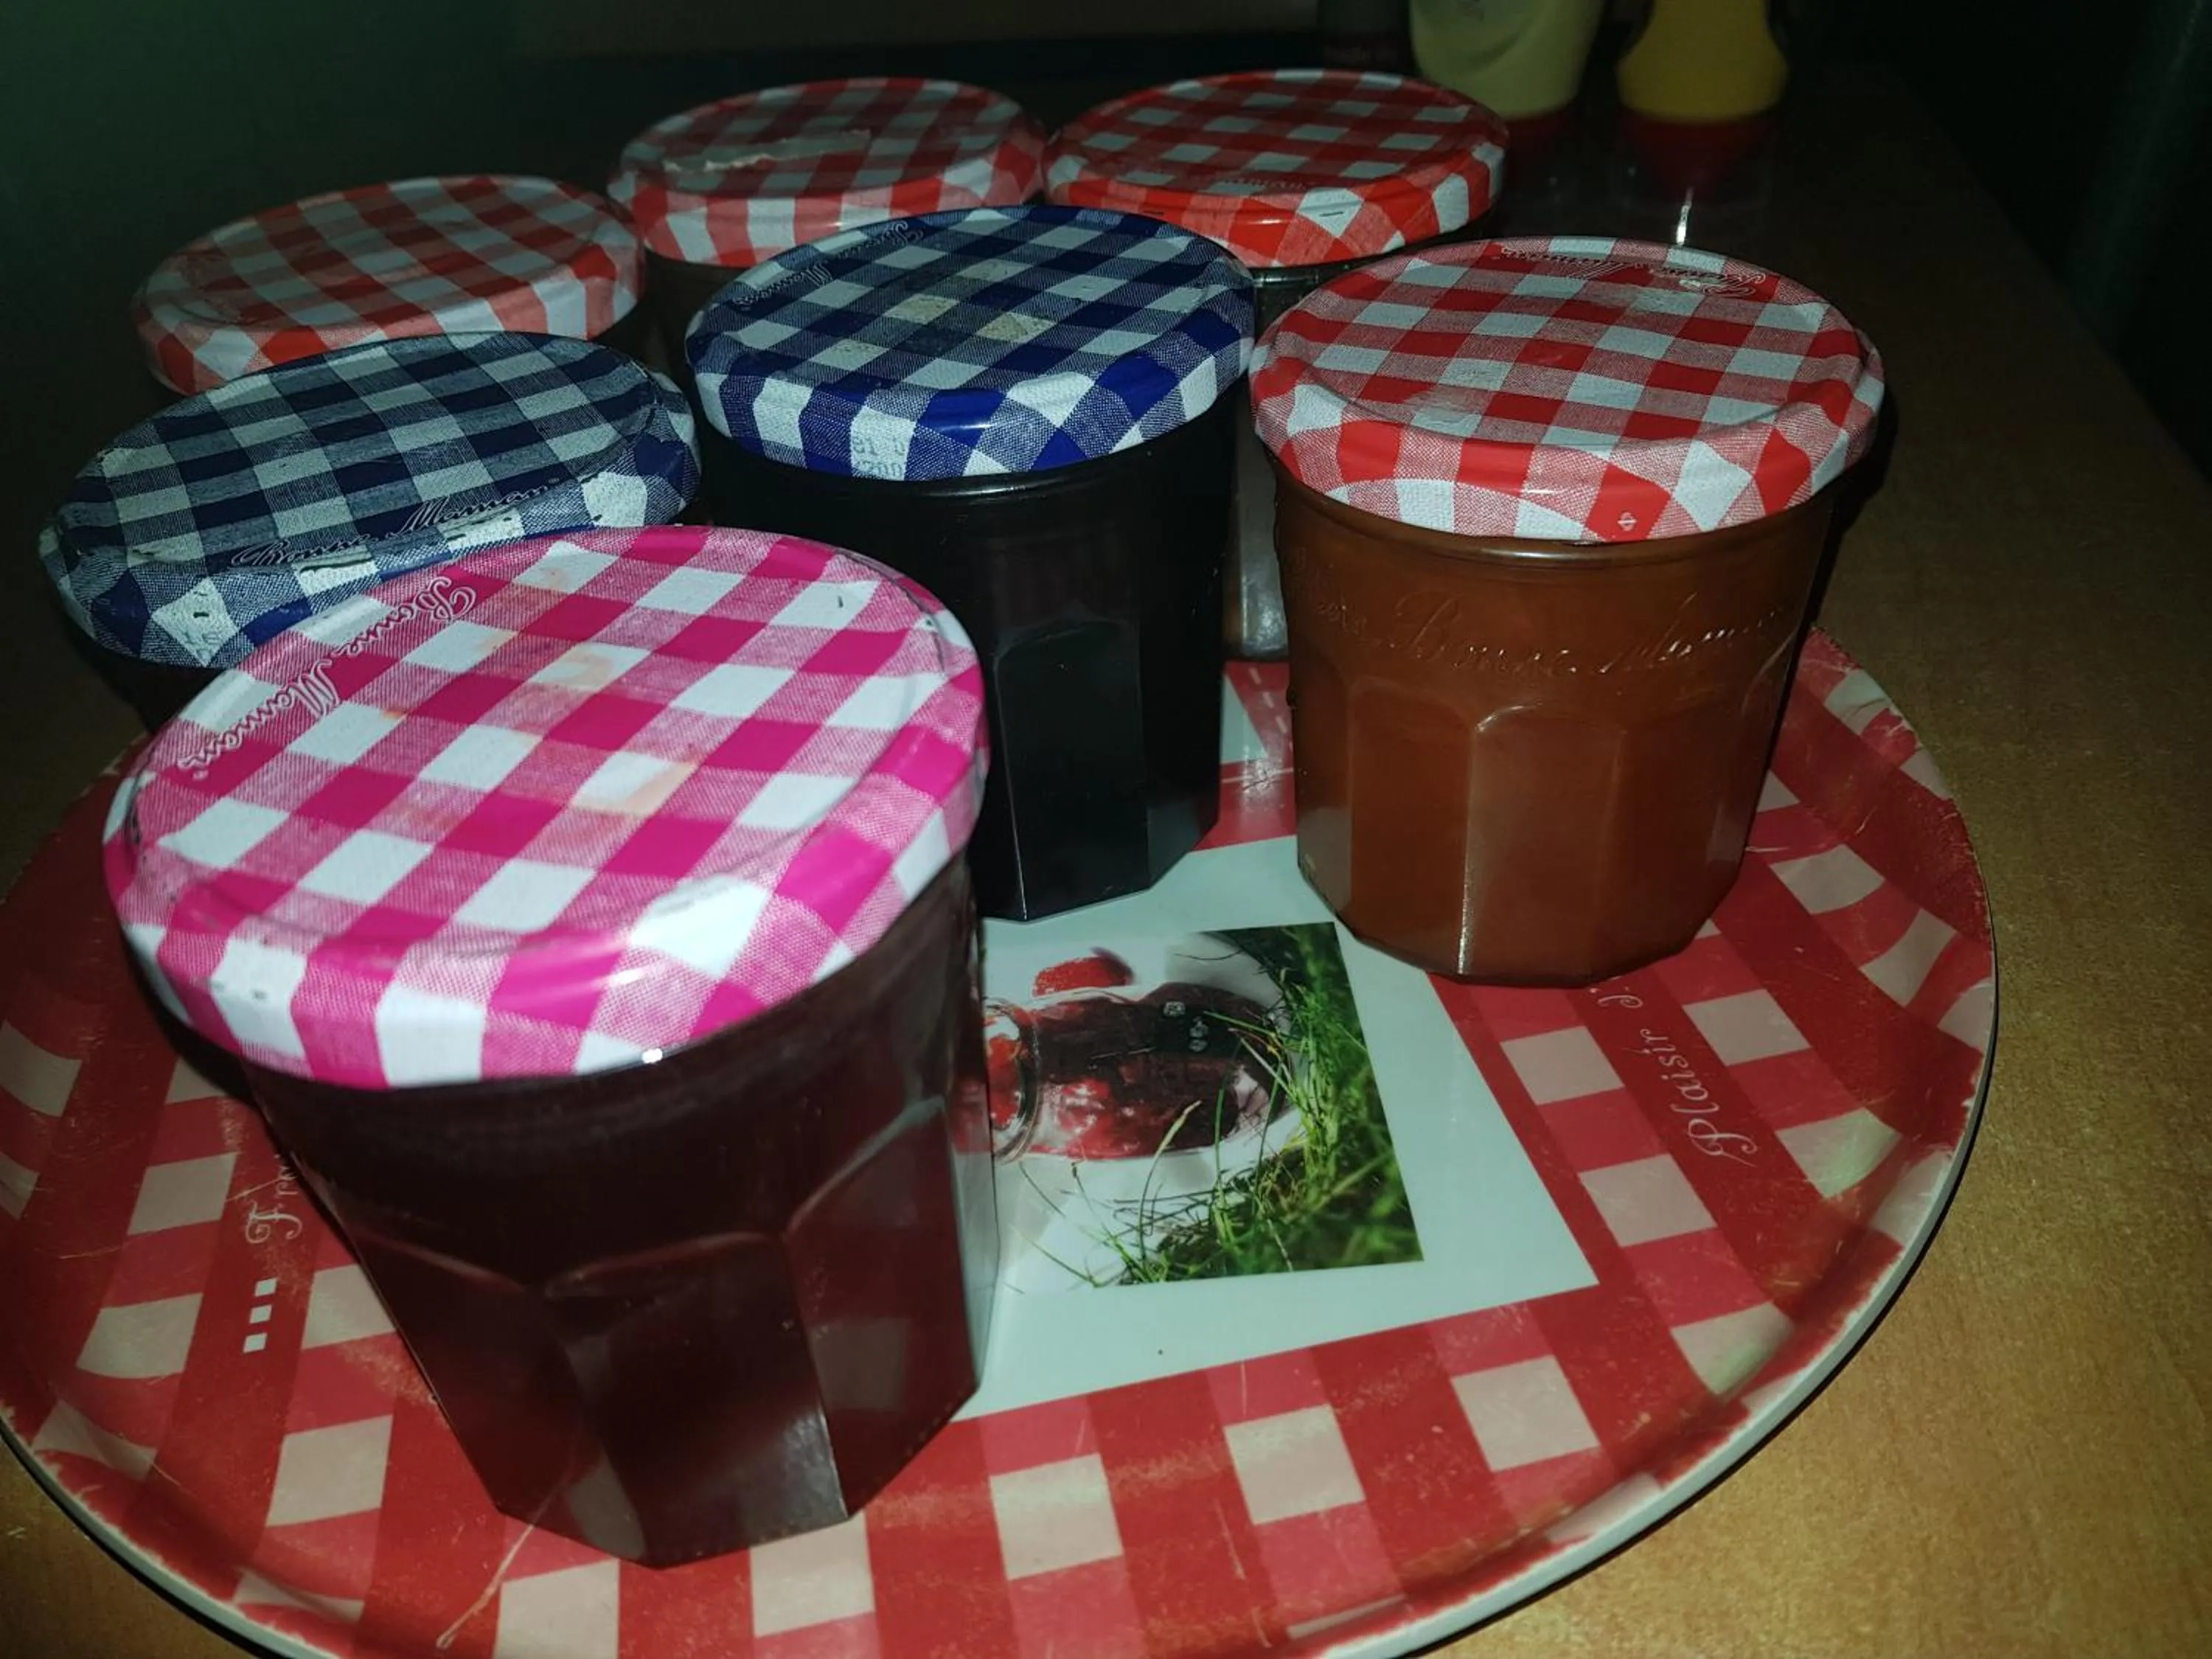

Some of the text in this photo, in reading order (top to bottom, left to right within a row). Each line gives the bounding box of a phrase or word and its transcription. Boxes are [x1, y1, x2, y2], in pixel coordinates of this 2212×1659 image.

[230, 484, 549, 566] Bonne Maman
[335, 575, 478, 658] Bonne
[177, 658, 341, 769] Maman
[1640, 1028, 1759, 1168] Plaisir
